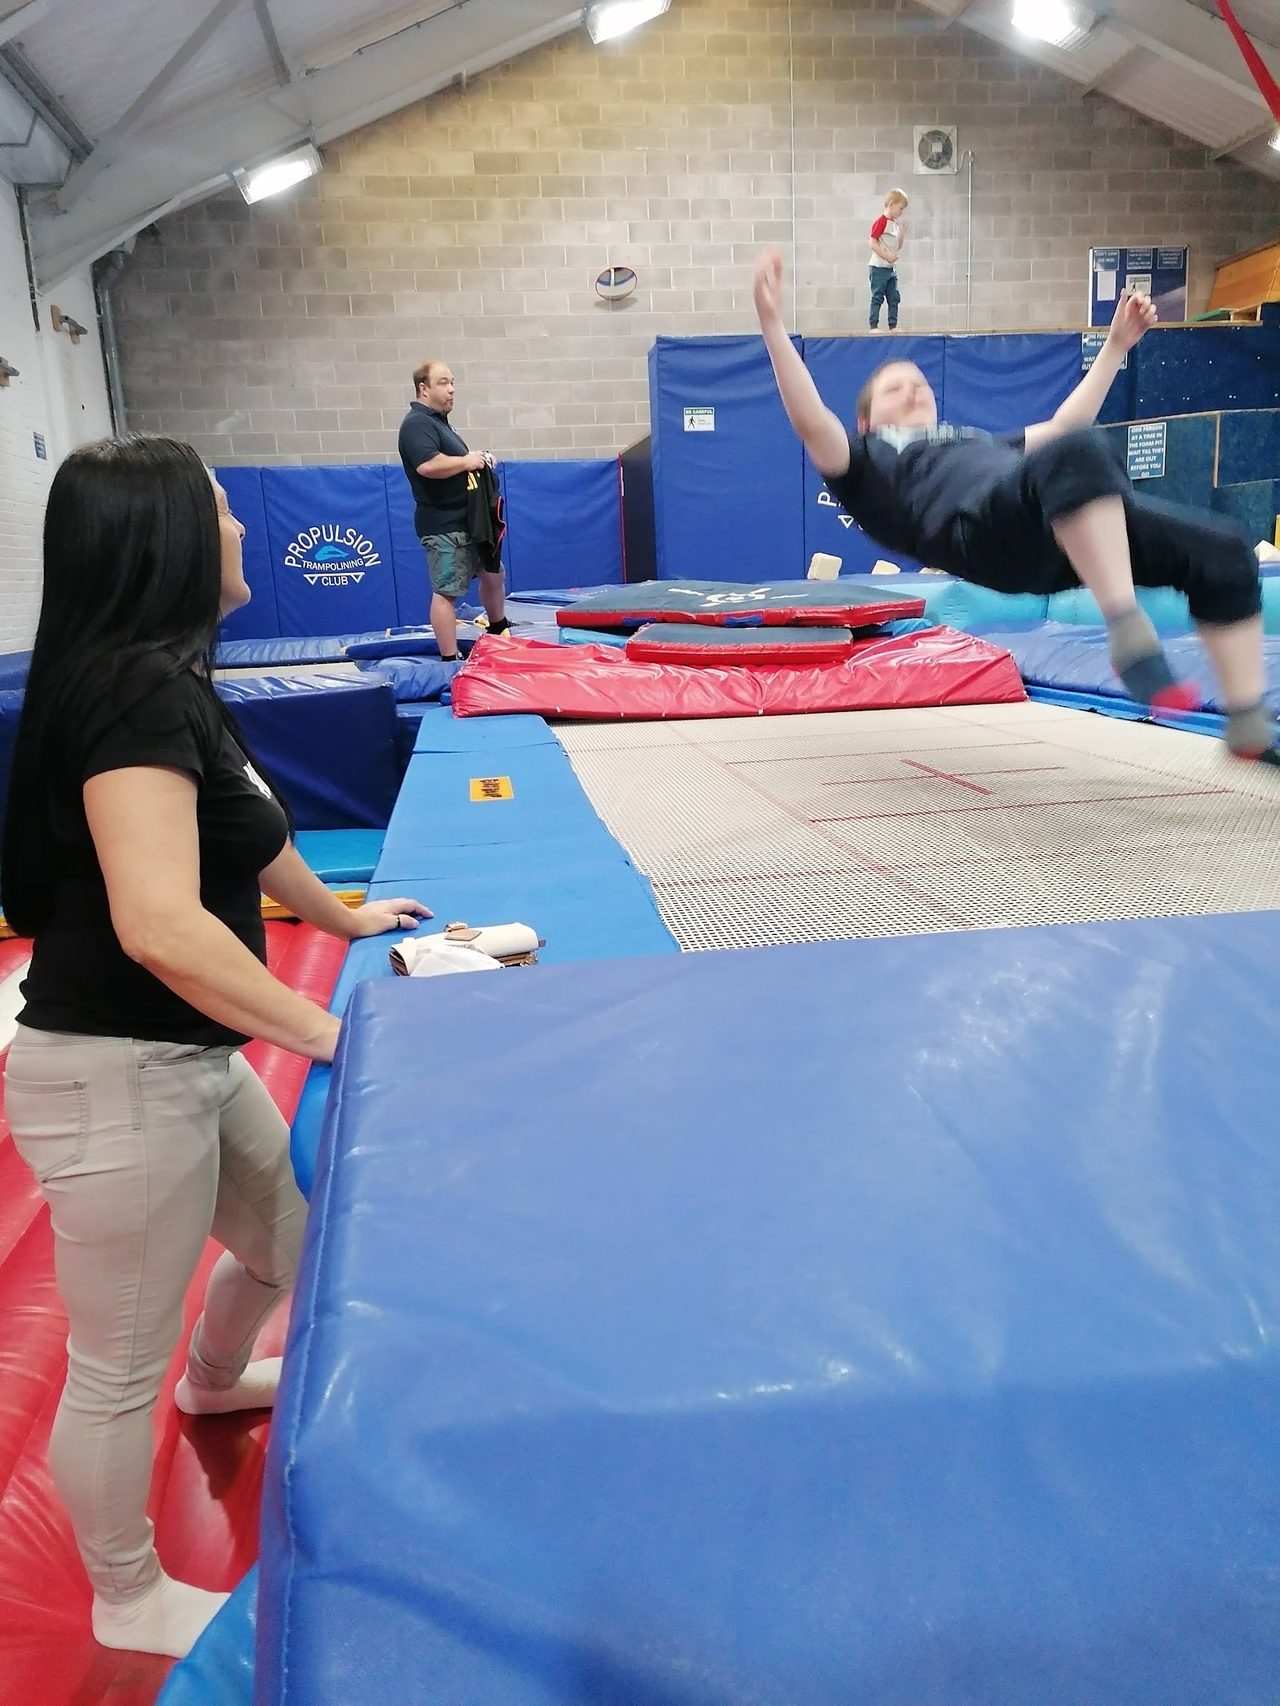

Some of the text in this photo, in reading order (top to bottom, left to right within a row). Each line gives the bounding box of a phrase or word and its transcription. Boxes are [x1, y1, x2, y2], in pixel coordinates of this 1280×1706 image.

[1130, 463, 1149, 471] BEFORE
[284, 524, 381, 568] PROPULSION
[302, 558, 364, 571] TRAMPOLINING
[321, 576, 349, 586] CLUB
